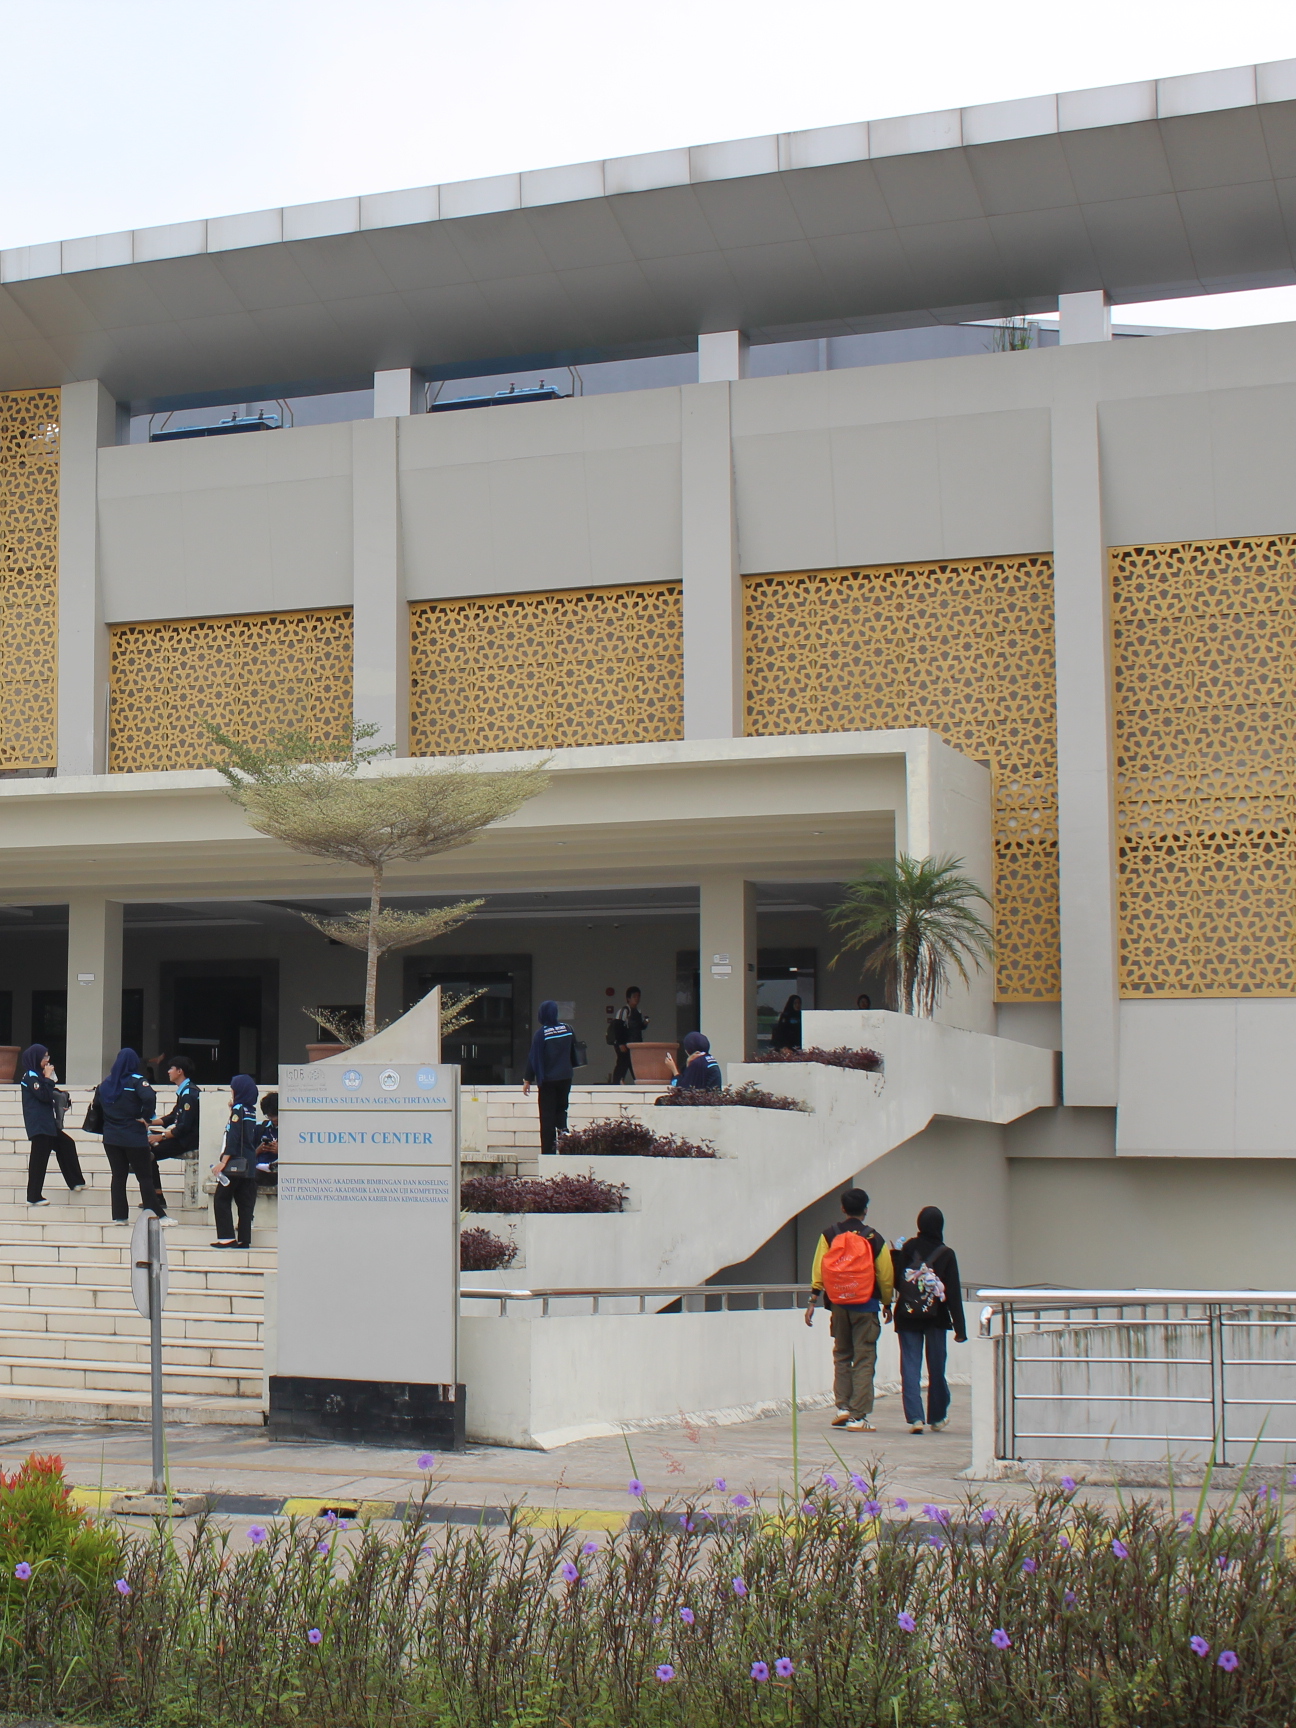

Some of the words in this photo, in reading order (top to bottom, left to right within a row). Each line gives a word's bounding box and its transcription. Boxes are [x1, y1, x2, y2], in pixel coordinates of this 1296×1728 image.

[286, 1096, 339, 1104] UNIVERSITAS
[340, 1096, 371, 1104] SULTAN
[372, 1096, 401, 1104] AGENG
[402, 1096, 447, 1104] TIRTAYASA
[298, 1131, 368, 1144] STUDENT
[371, 1131, 434, 1145] CENTER
